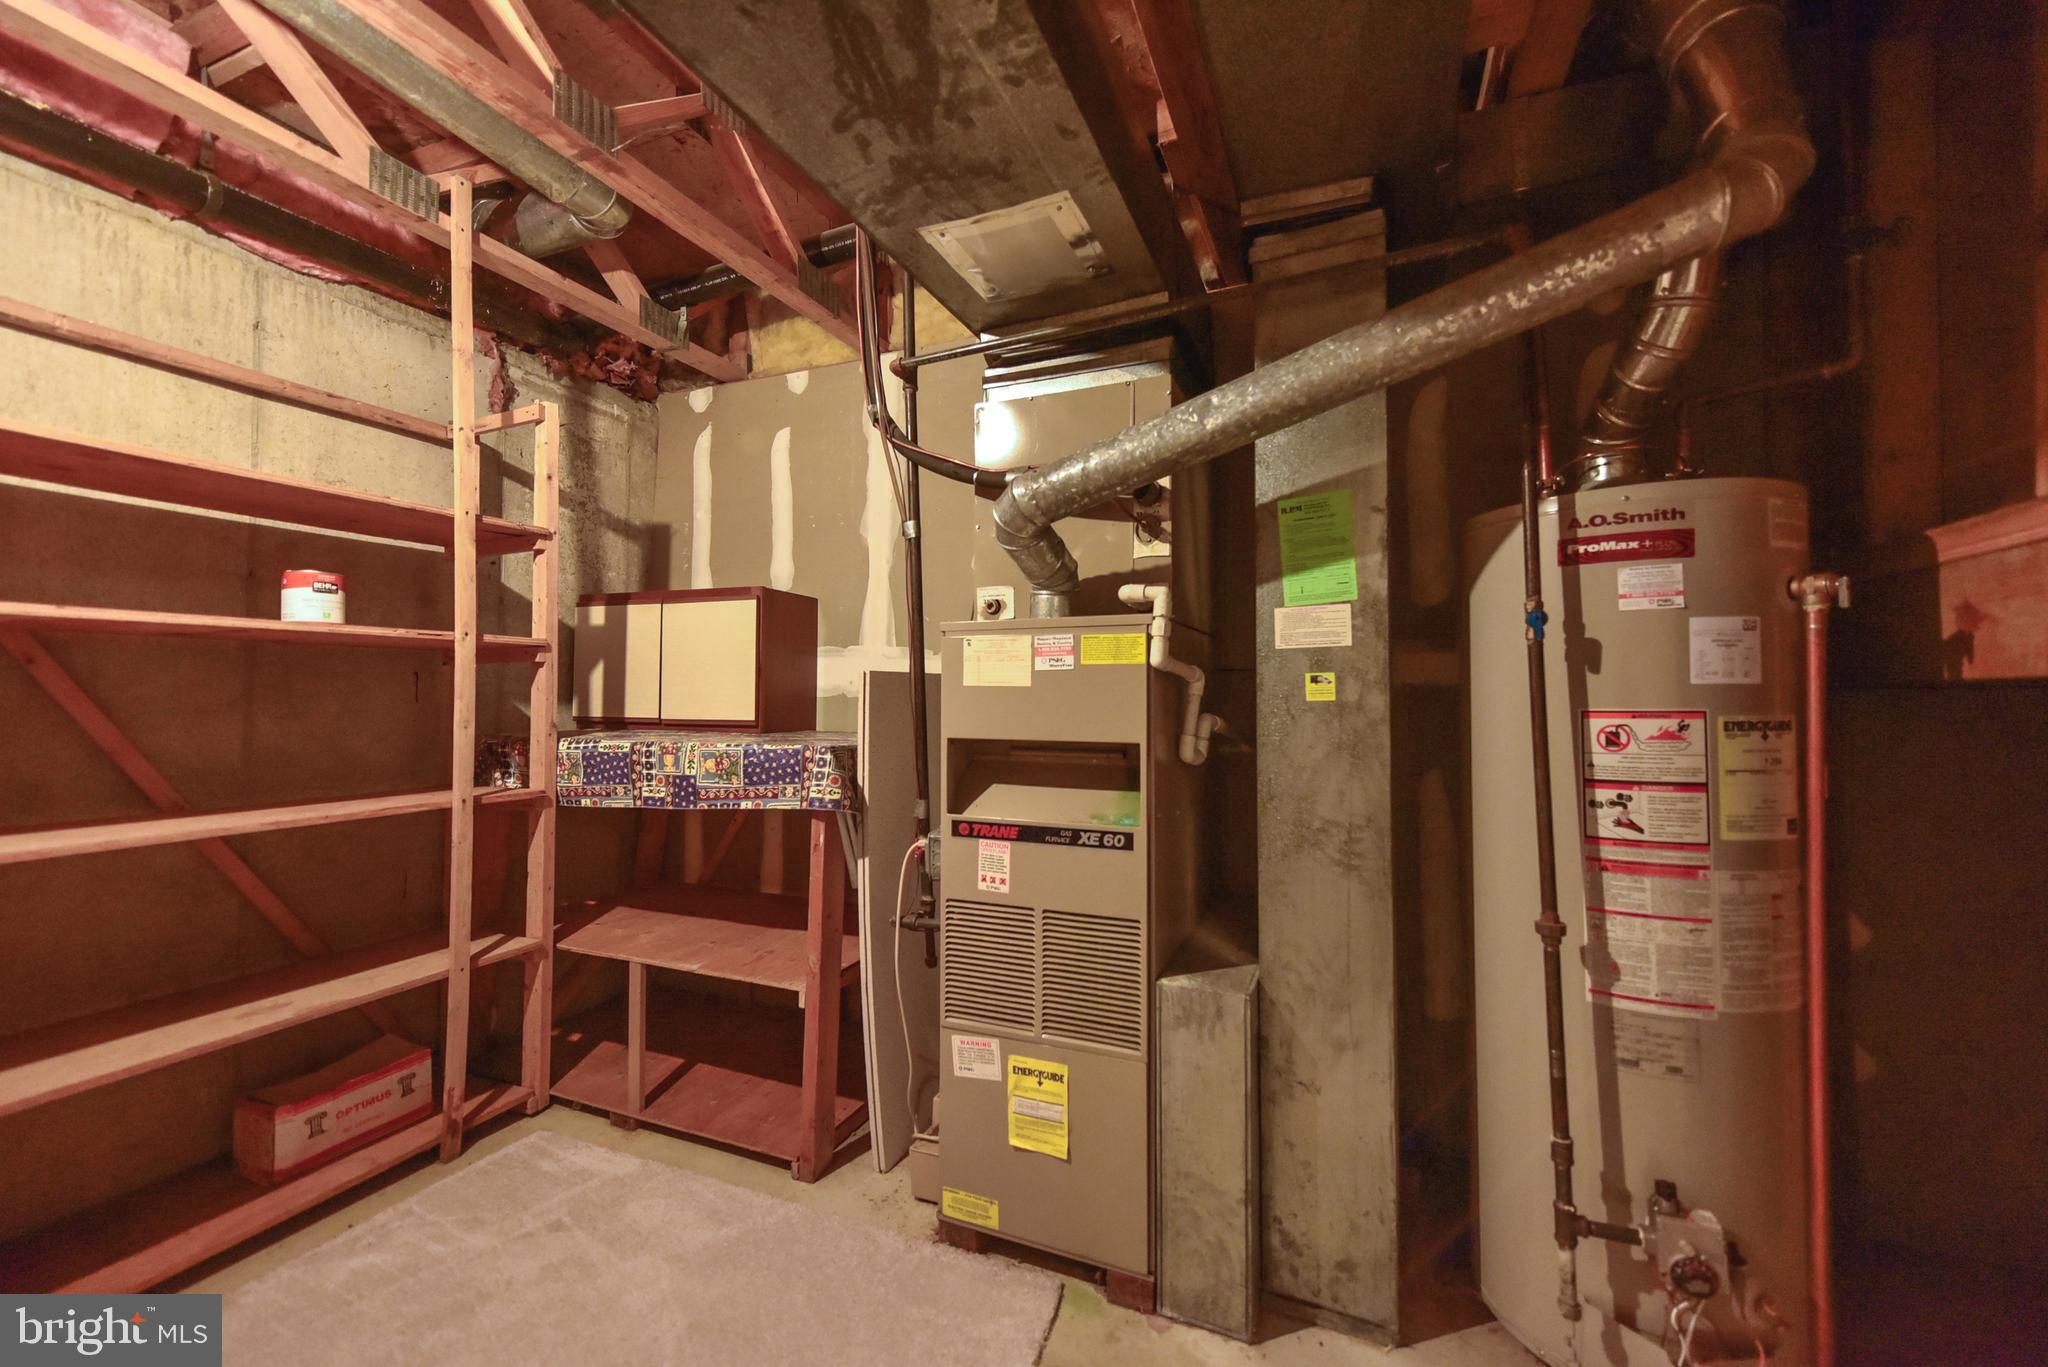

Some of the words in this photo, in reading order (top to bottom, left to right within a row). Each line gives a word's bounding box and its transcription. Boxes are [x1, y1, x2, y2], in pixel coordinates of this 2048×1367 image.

[972, 824, 1020, 839] TRANE
[1077, 831, 1101, 846] XE
[1103, 834, 1125, 848] 60
[980, 841, 1009, 850] CAUTION
[960, 1040, 992, 1049] WARNING
[1012, 1065, 1065, 1084] ENERGYGUIDE
[335, 1089, 392, 1120] OPTIMUS
